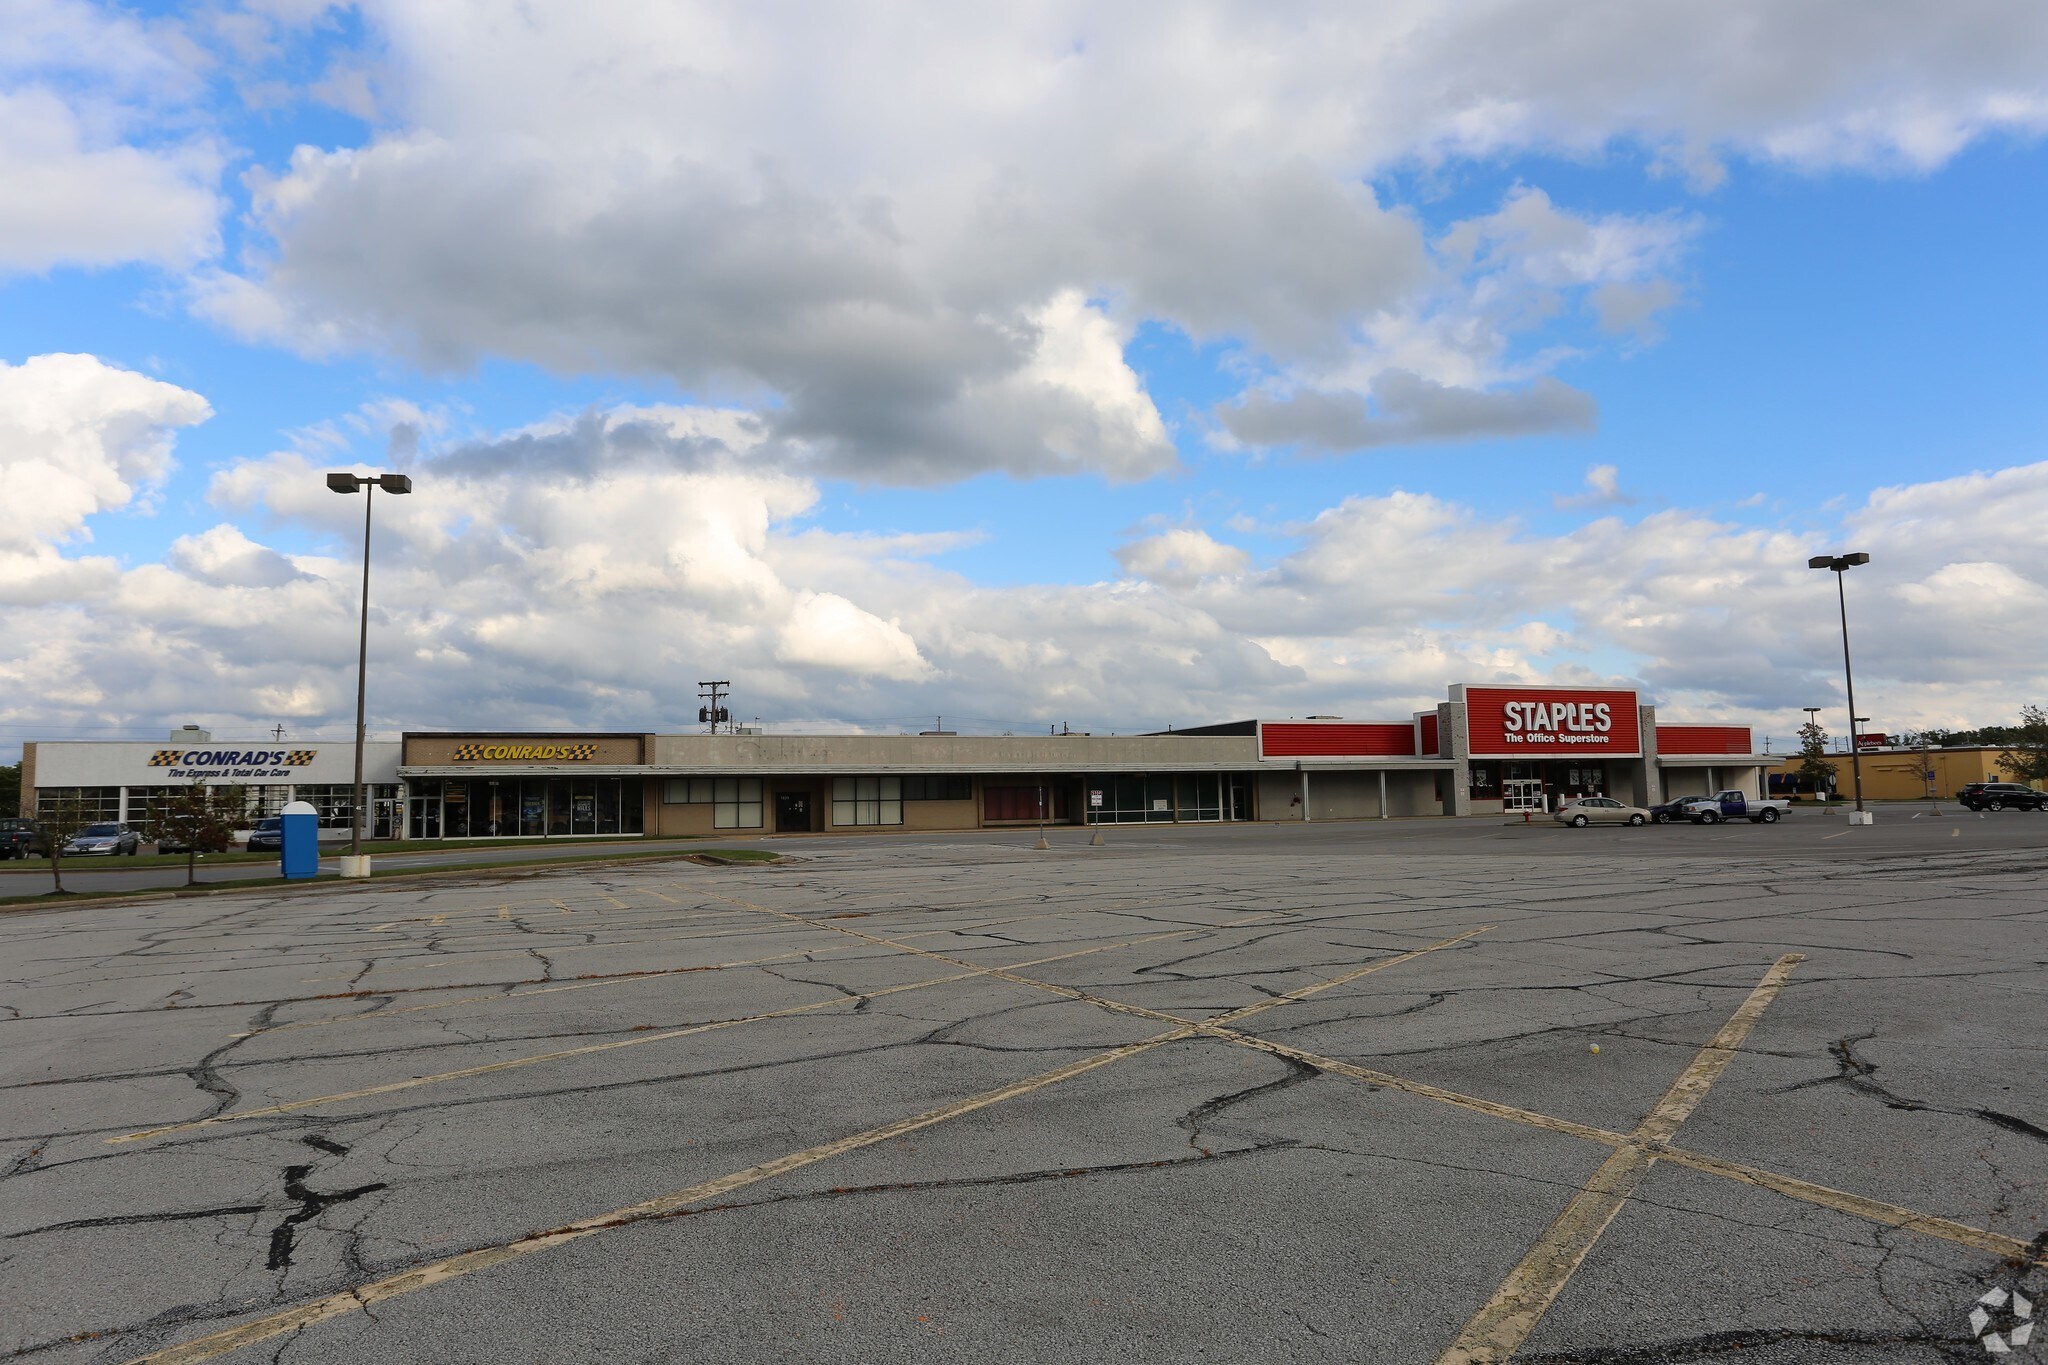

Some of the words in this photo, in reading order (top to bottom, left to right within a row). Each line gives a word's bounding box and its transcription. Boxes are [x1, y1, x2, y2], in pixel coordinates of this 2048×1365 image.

[1504, 701, 1612, 732] STAPLES
[1504, 733, 1523, 743] The
[1526, 733, 1555, 743] Office
[1558, 733, 1609, 744] Superstore
[182, 750, 286, 766] CONRAD'S
[482, 745, 571, 760] CONRAD'S
[168, 769, 185, 778] Tire
[186, 769, 220, 778] Express
[221, 769, 229, 777] &
[231, 768, 252, 777] Total
[253, 769, 268, 777] Car
[269, 769, 291, 777] Care
